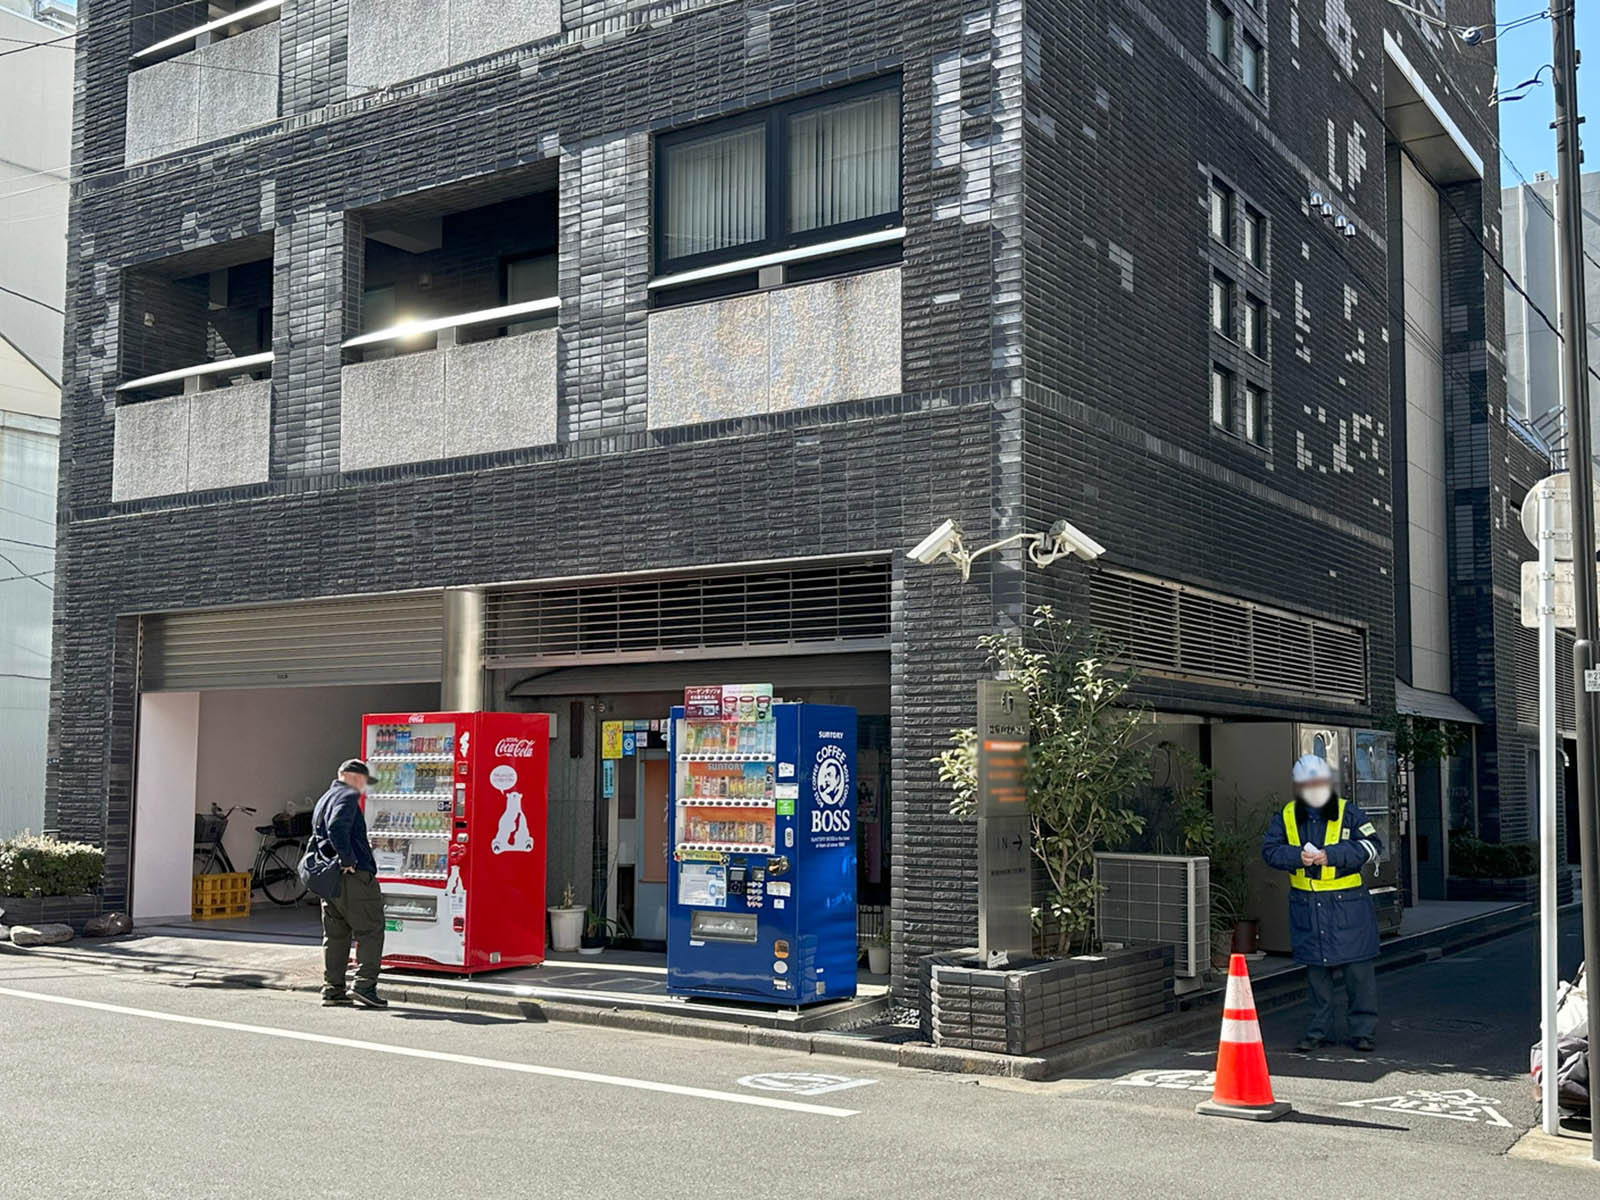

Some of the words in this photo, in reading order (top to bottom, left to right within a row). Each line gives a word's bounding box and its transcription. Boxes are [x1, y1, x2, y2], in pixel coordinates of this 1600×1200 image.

[818, 731, 844, 739] SUNTORY
[816, 745, 847, 764] COFFEE
[707, 763, 744, 771] SUNTORY
[811, 809, 851, 832] BOSS
[996, 836, 1008, 849] IN
